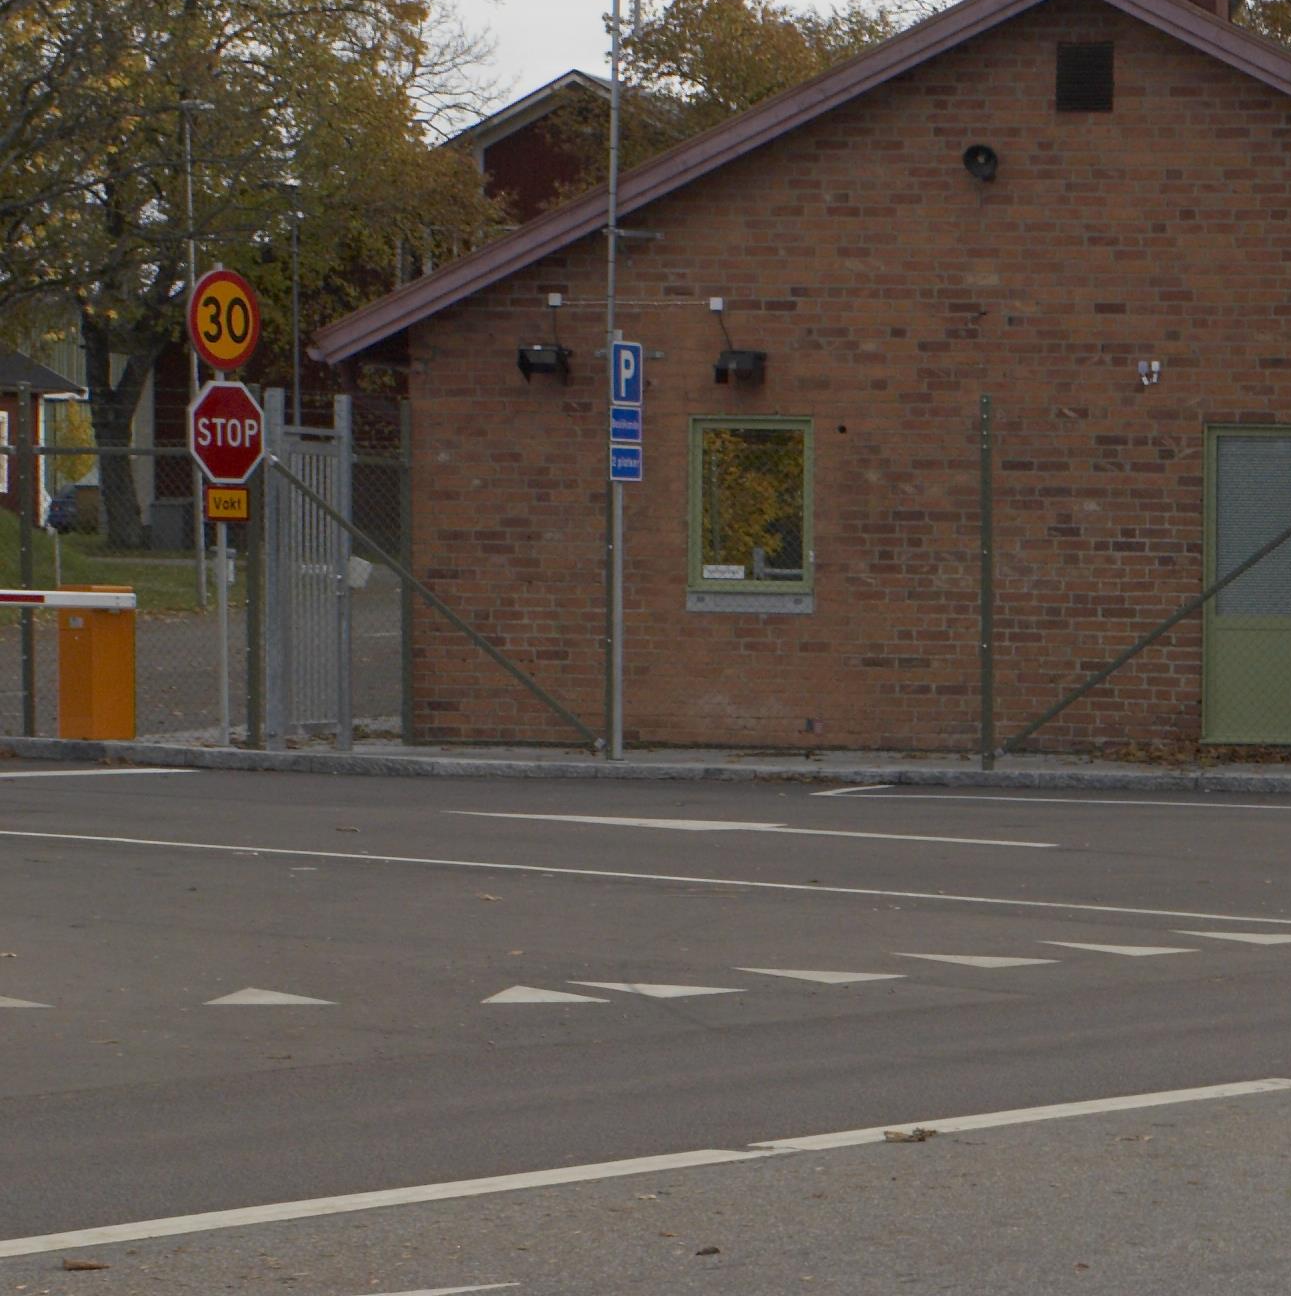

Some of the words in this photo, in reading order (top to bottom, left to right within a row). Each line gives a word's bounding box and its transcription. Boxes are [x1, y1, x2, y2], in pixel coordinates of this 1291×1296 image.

[202, 296, 249, 344] 30
[620, 349, 635, 398] P
[197, 418, 259, 448] STOP
[213, 496, 242, 511] Vakt
